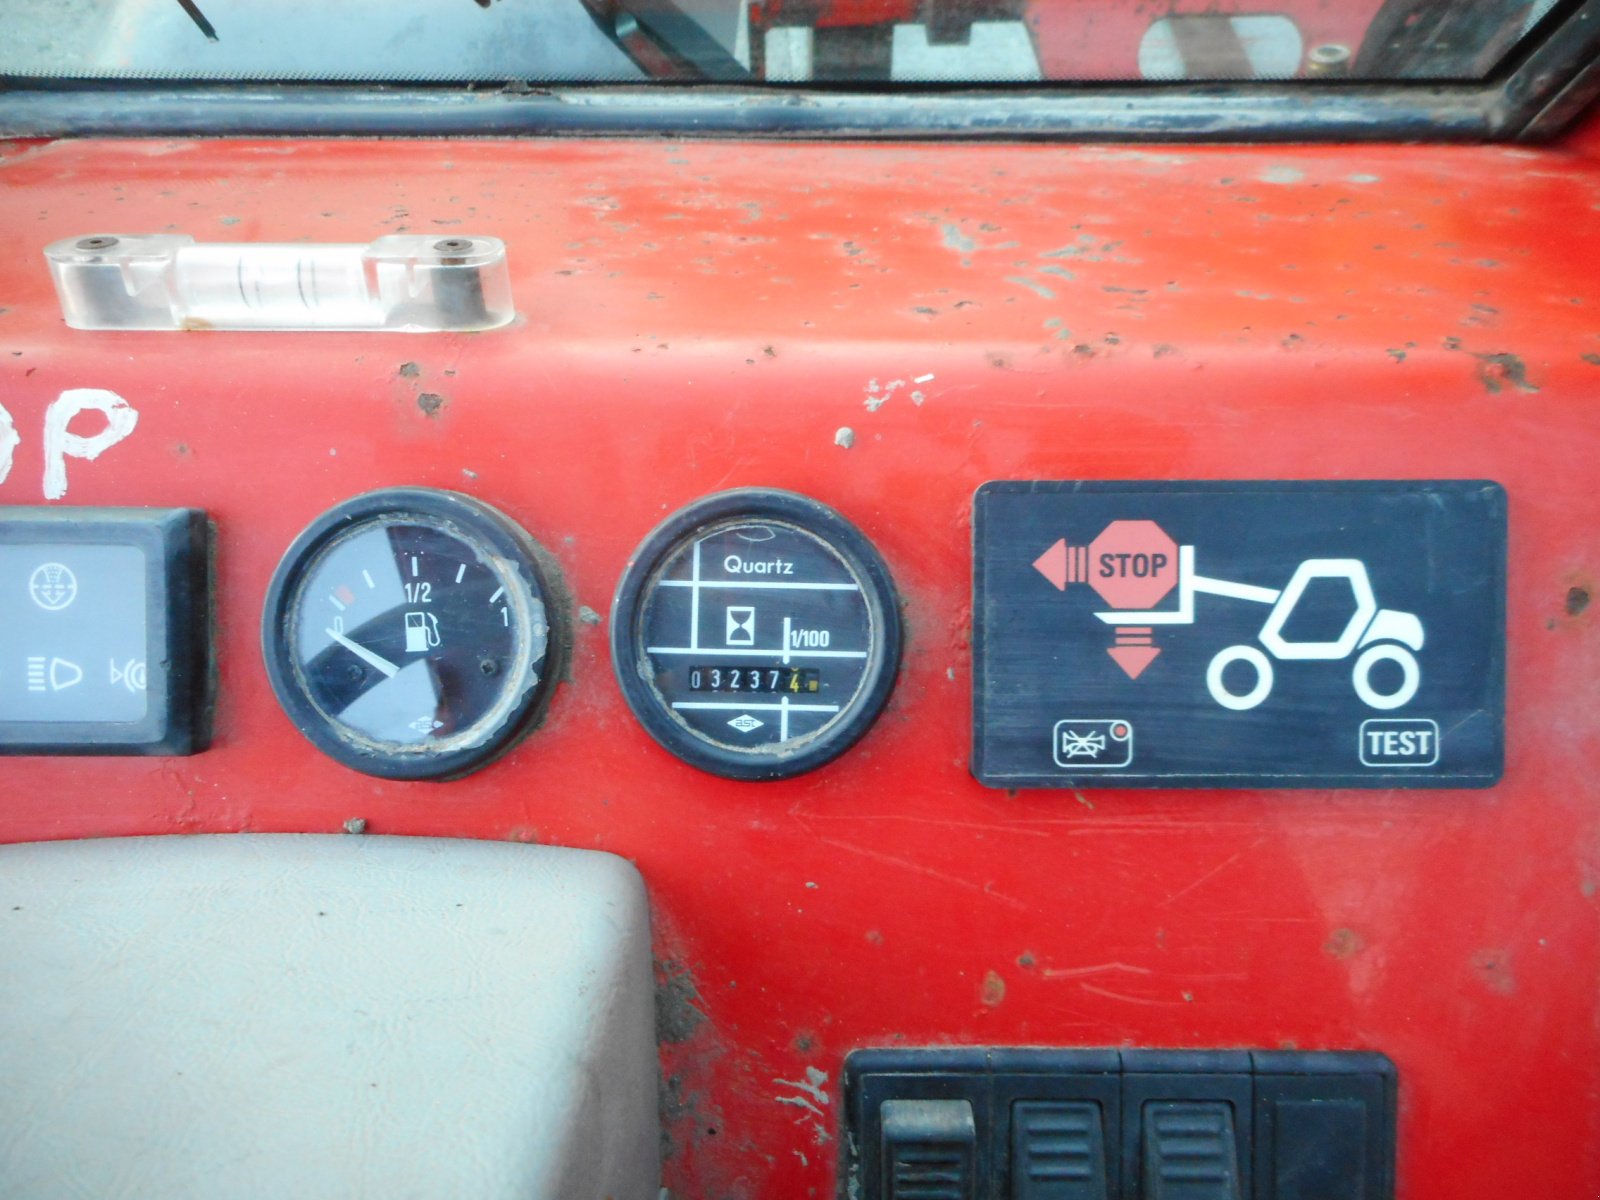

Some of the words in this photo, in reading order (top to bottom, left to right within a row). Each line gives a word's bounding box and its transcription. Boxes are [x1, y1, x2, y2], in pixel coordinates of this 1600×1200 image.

[723, 555, 794, 575] Quartz
[1098, 552, 1168, 578] STOP
[404, 582, 432, 603] 1/2
[500, 606, 508, 627] 1
[790, 629, 830, 648] 1/100
[1366, 731, 1433, 755] TEST
